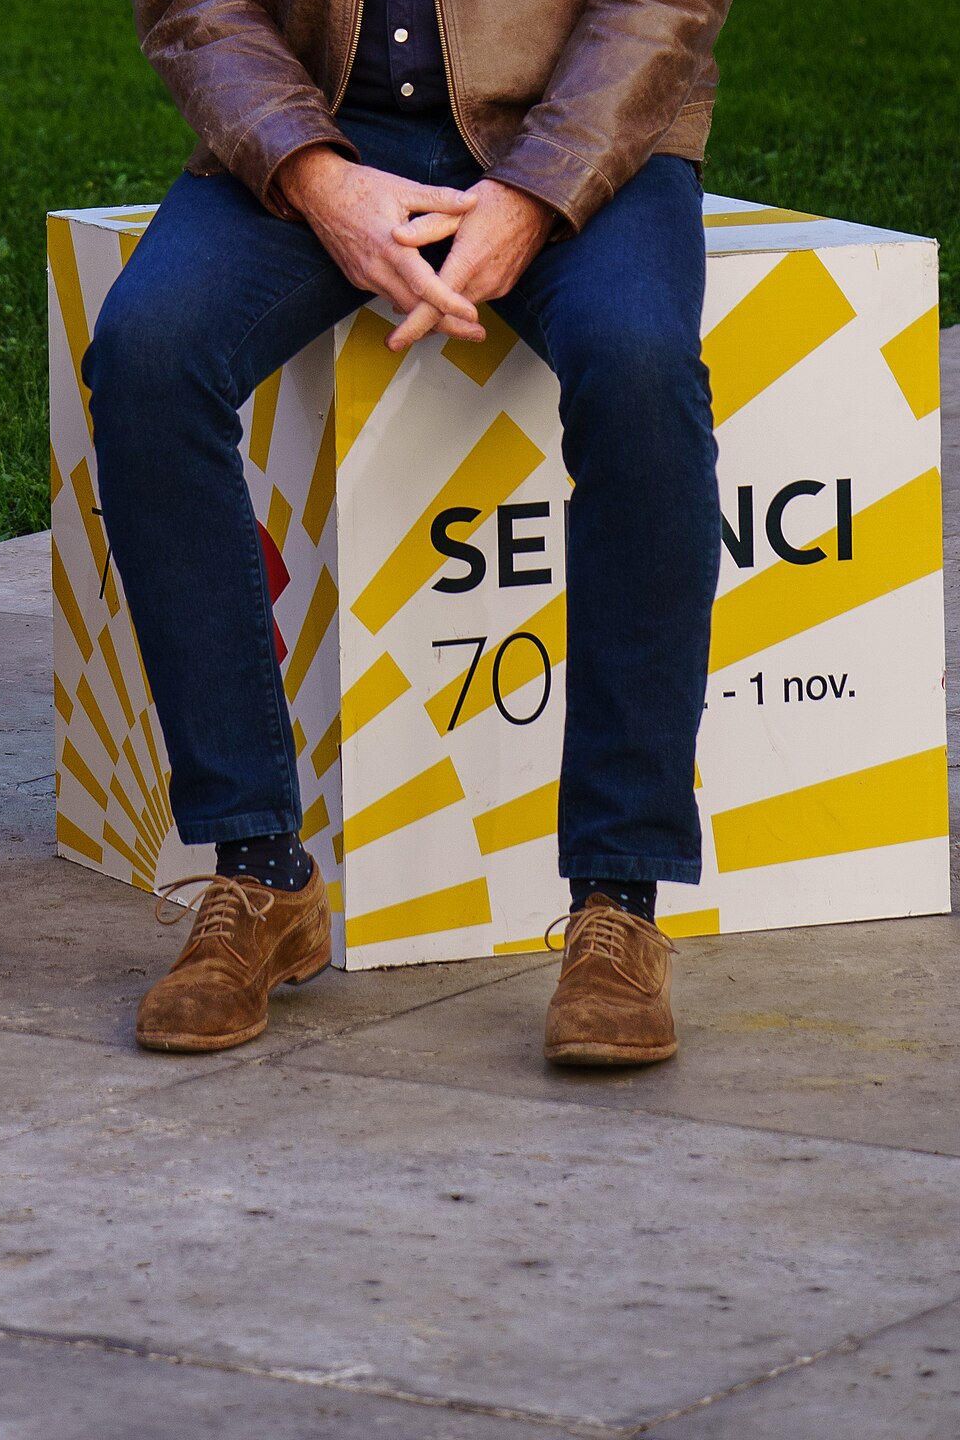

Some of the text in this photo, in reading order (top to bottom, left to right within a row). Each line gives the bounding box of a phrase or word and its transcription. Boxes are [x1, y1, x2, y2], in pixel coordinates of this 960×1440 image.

[429, 478, 853, 594] SENCI
[432, 631, 552, 731] 70
[750, 671, 764, 705] 1
[783, 672, 856, 703] nov.
